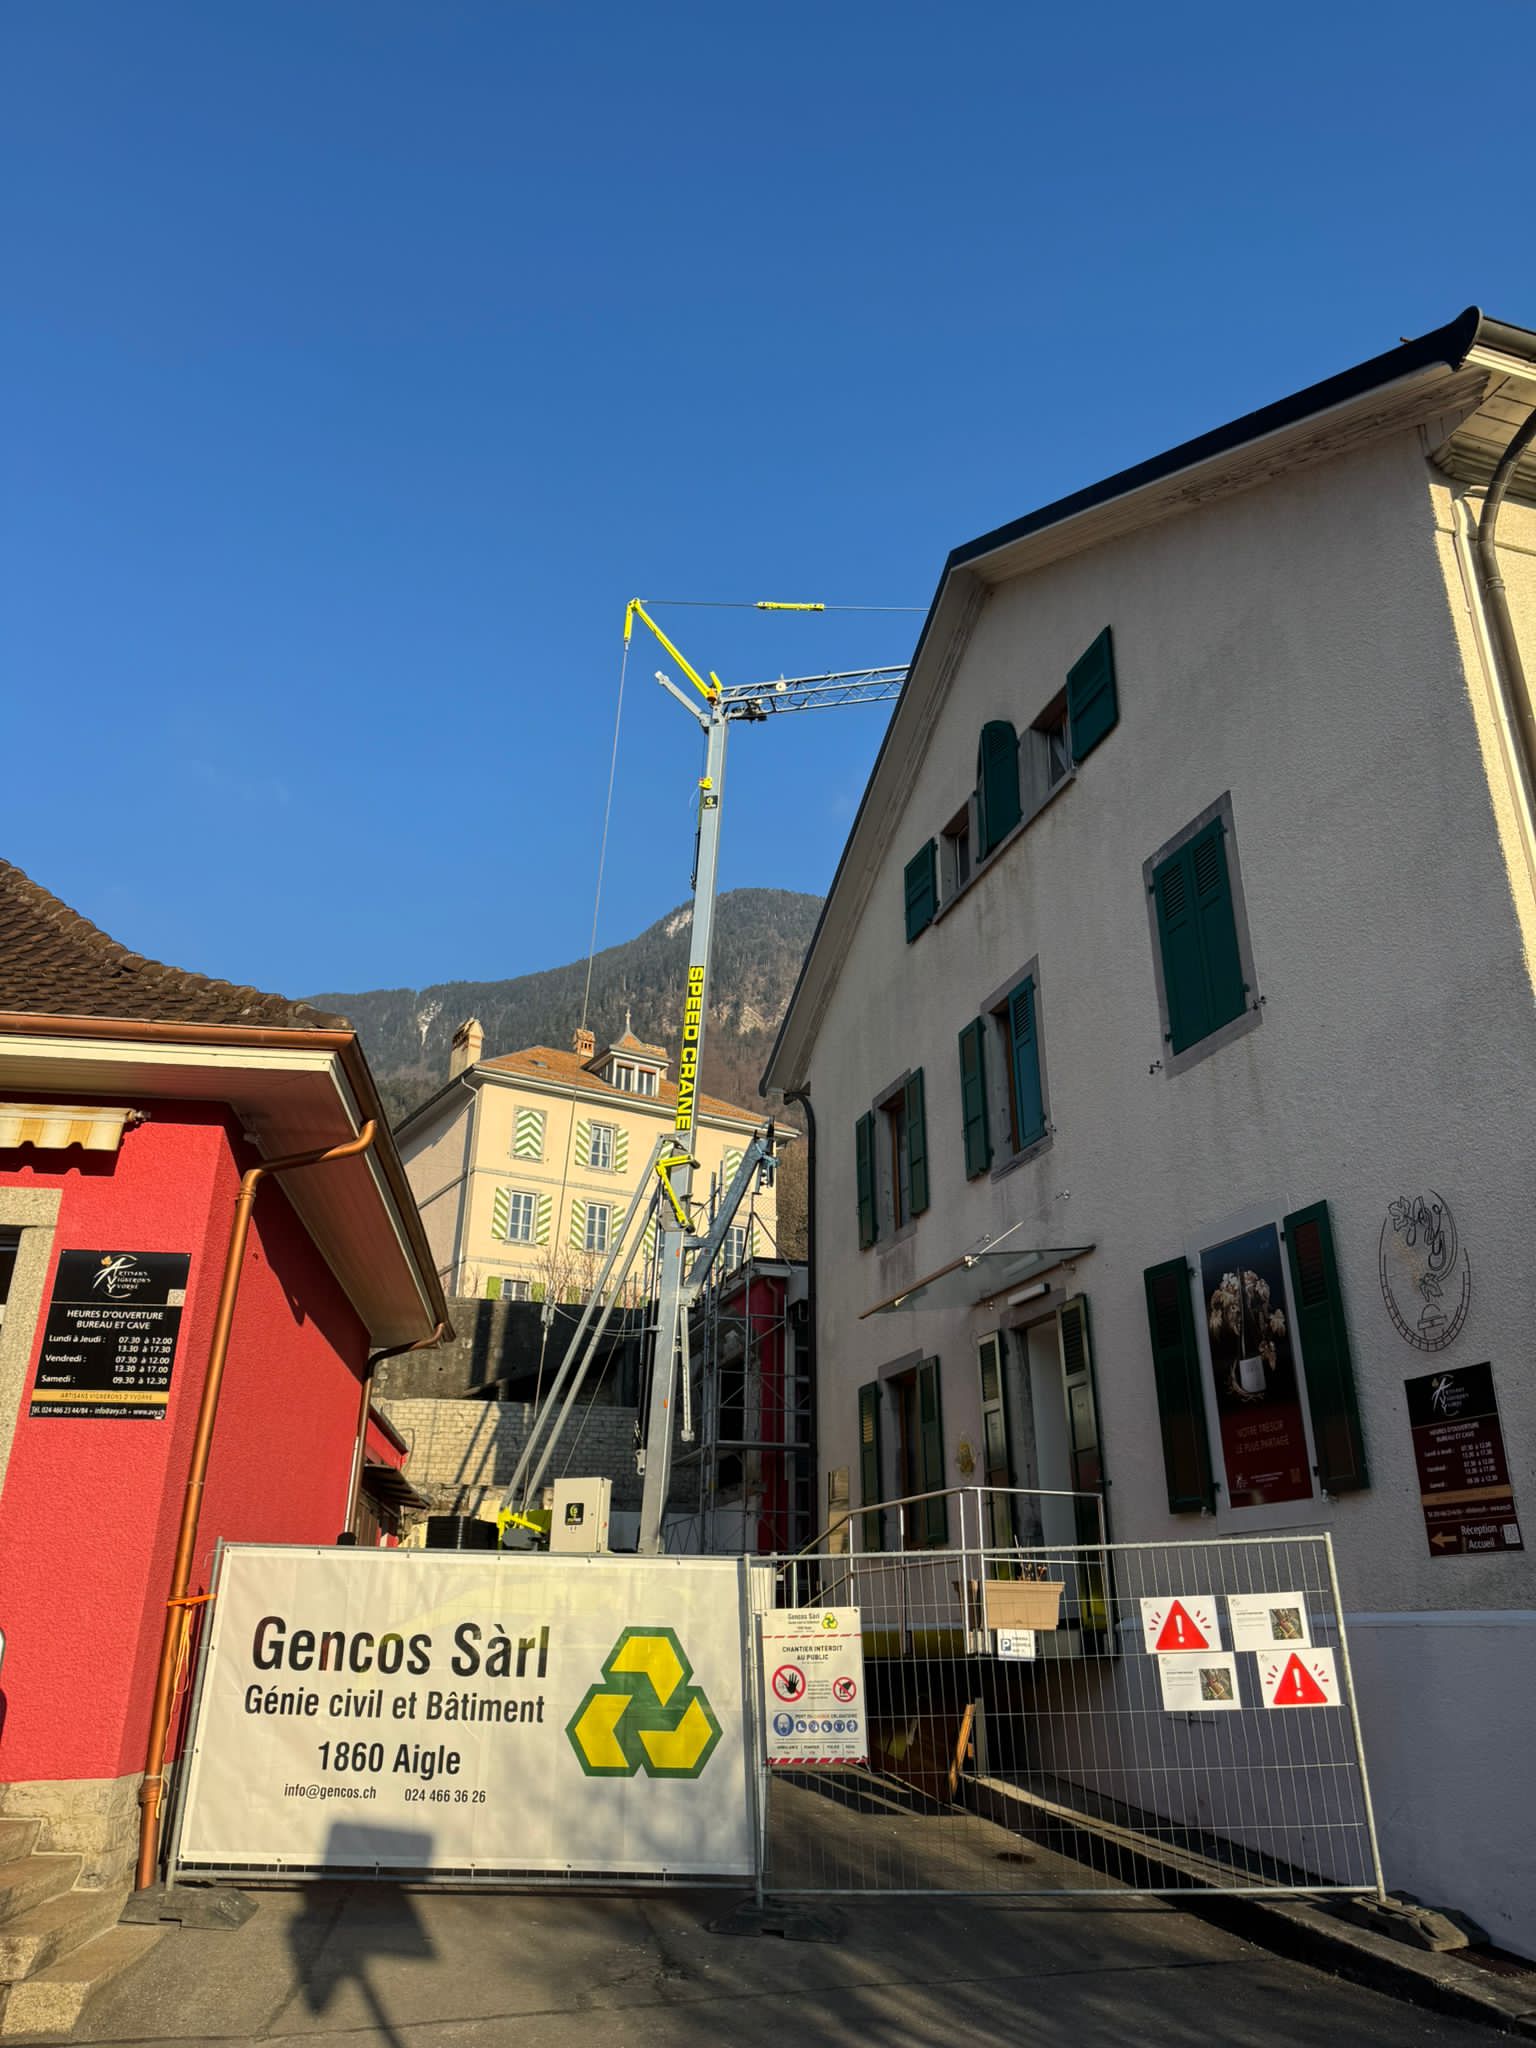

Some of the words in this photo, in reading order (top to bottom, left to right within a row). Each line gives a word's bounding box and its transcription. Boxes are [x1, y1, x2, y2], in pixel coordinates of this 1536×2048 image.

[684, 966, 704, 1041] SPEED
[676, 1047, 697, 1131] CRANE
[66, 1310, 100, 1319] HEURES
[102, 1311, 164, 1320] D'OUVERTURE
[76, 1320, 112, 1329] BUREAU
[114, 1321, 125, 1330] ET
[126, 1322, 150, 1330] CAVE
[48, 1334, 72, 1343] Lundi
[72, 1335, 78, 1343] à
[80, 1334, 101, 1343] Jeudi
[144, 1336, 150, 1344] à
[152, 1337, 172, 1345] 12.00
[118, 1345, 138, 1353] 13.30
[150, 1346, 170, 1354] 17.30
[45, 1354, 82, 1363] Vendredi
[140, 1356, 146, 1364] à
[114, 1365, 136, 1373] 13.30
[147, 1366, 168, 1374] 17.00
[41, 1375, 72, 1384] Samedi
[112, 1376, 134, 1384] 09.30
[146, 1377, 168, 1385] 12.30
[1460, 1524, 1498, 1537] Réception
[1468, 1536, 1495, 1550] Accueil
[252, 1615, 432, 1676] Gencos
[450, 1621, 550, 1679] Sàrl
[782, 1645, 813, 1653] CHANTIER
[244, 1684, 319, 1716] Génie
[328, 1687, 384, 1719] civil
[392, 1692, 417, 1720] et
[426, 1690, 545, 1724] Bâtiment
[318, 1741, 384, 1774] 1860
[392, 1743, 462, 1781] Aigle
[284, 1782, 376, 1801] info@gencos.ch
[404, 1788, 426, 1802] 024
[429, 1788, 452, 1802] 466
[453, 1788, 469, 1803] 36
[471, 1788, 487, 1803] 26
